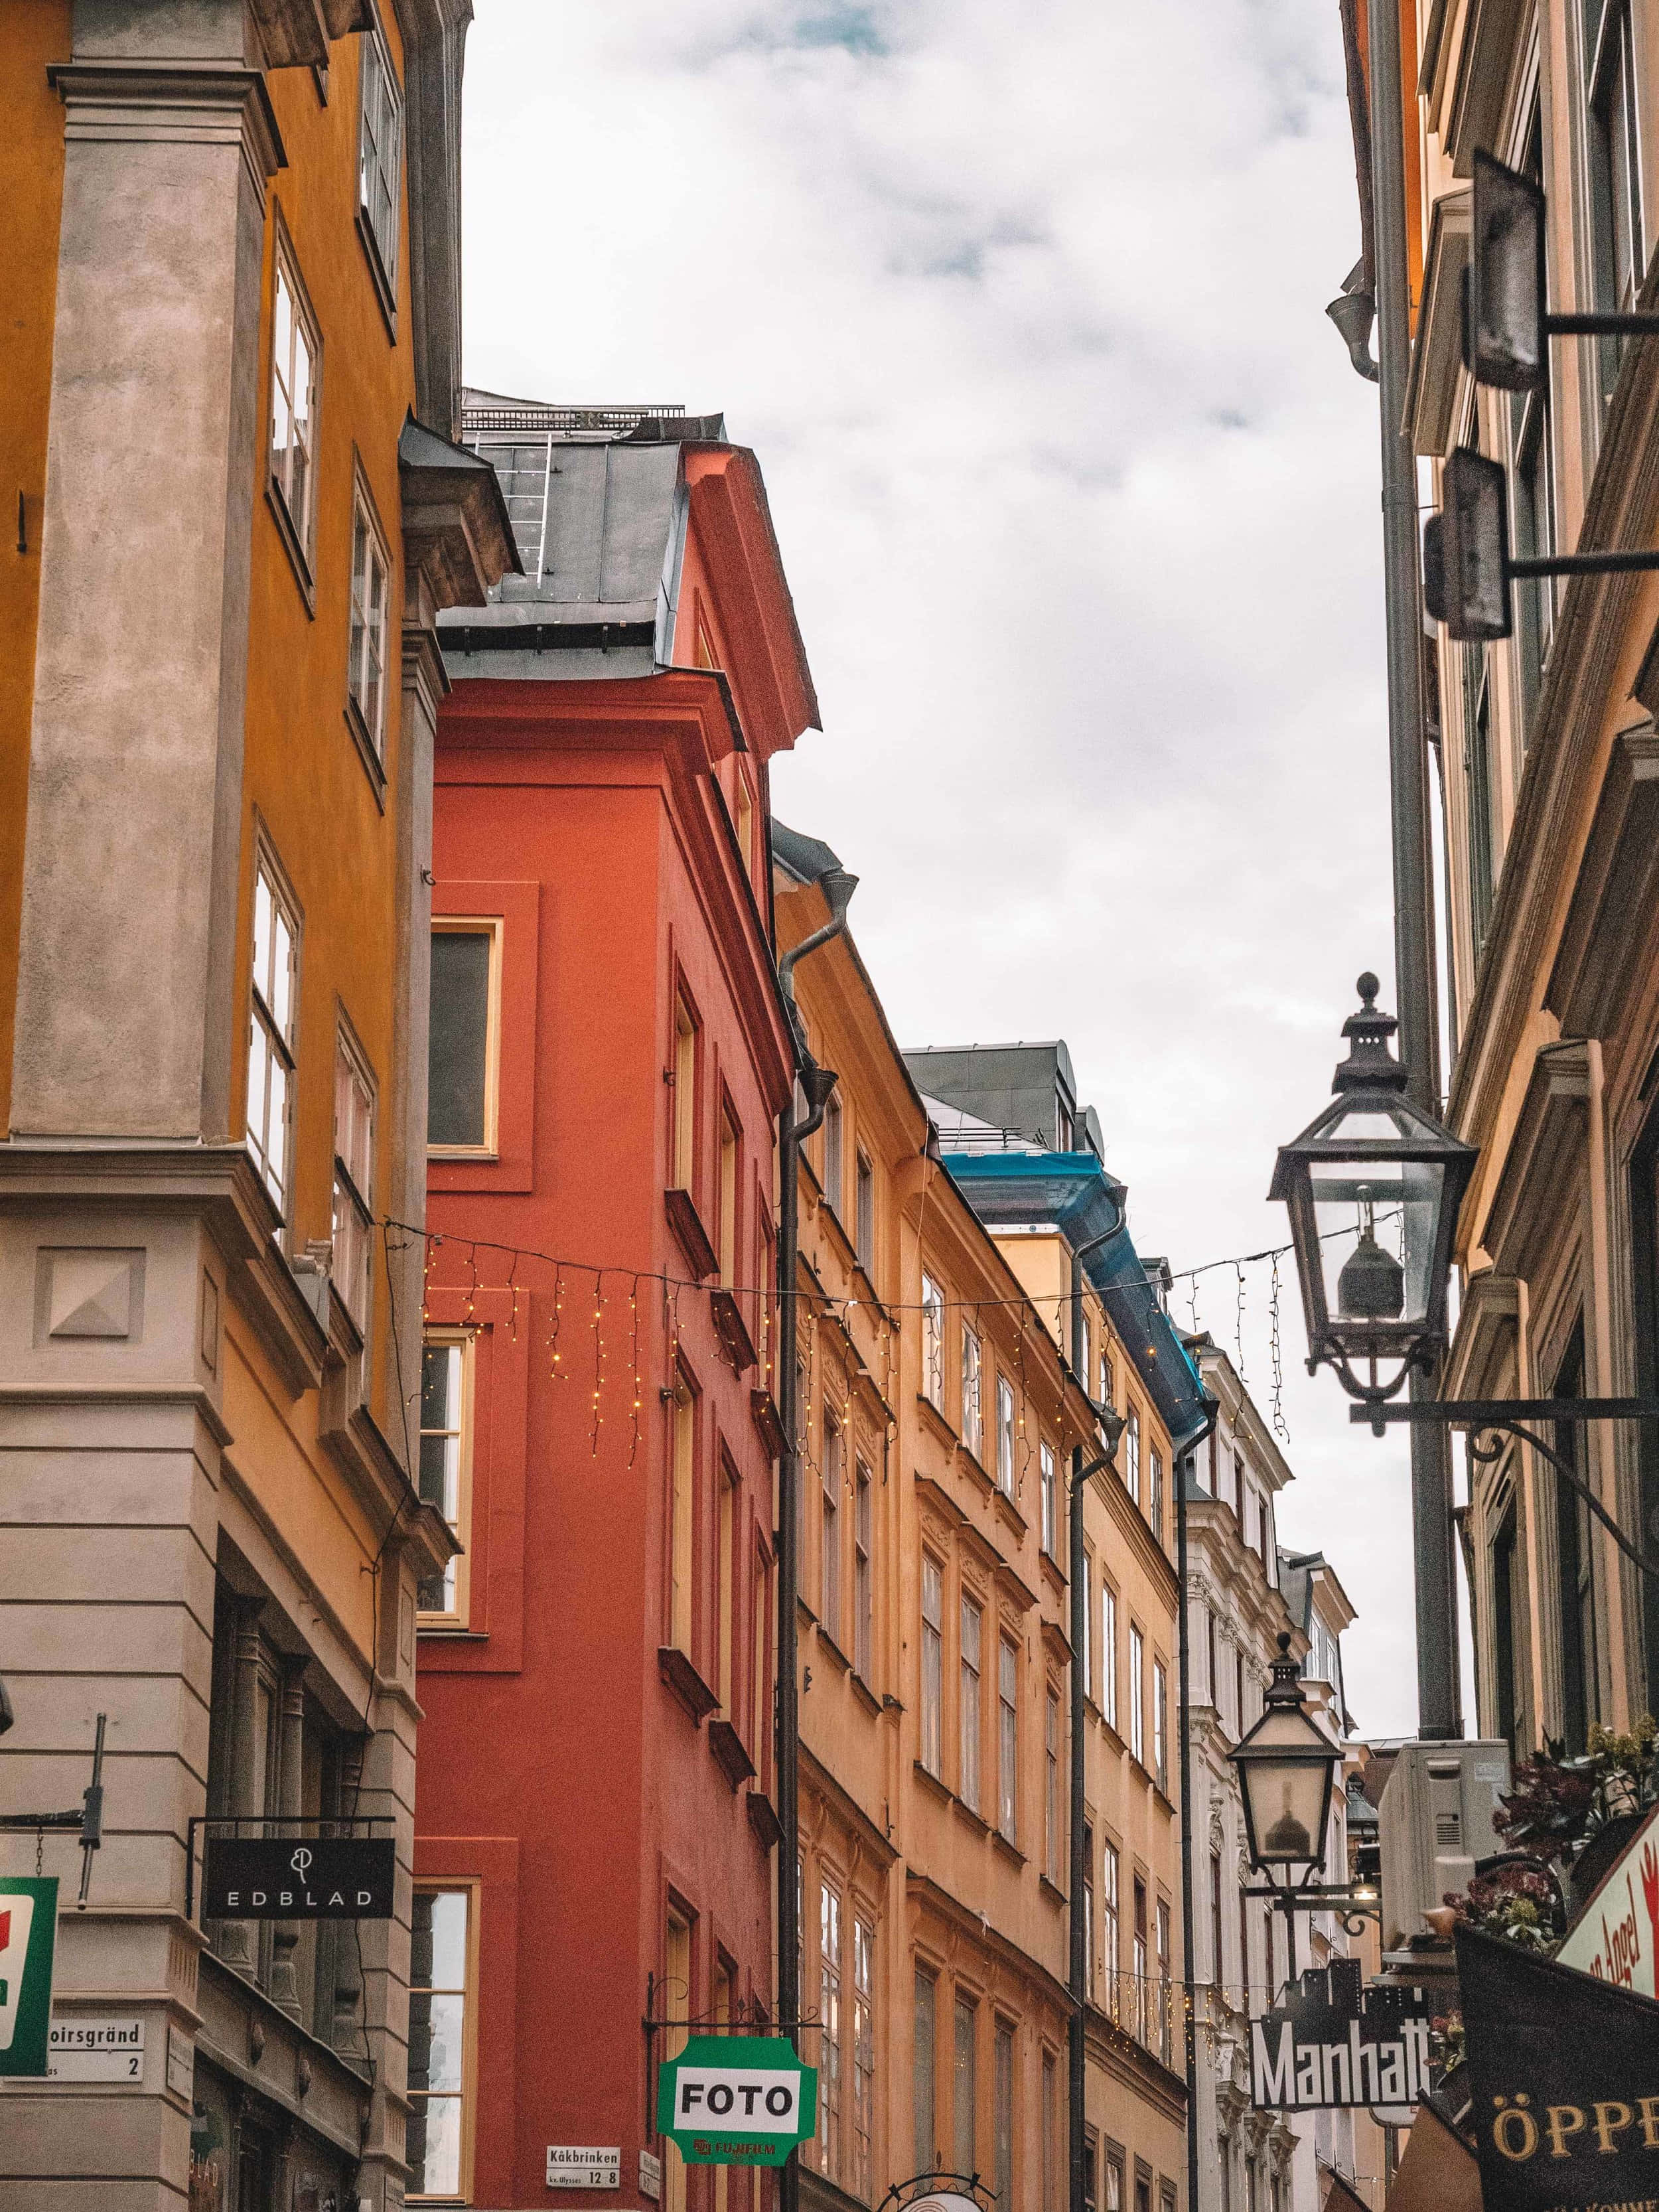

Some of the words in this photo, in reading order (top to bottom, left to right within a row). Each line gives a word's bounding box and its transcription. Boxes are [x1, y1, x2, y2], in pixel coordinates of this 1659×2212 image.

[228, 1891, 372, 1906] EDBLAD
[129, 2058, 139, 2075] 2
[1252, 2017, 1431, 2105] Manhatt
[682, 2083, 793, 2116] FOTO
[715, 2142, 775, 2155] FUJIFILM
[550, 2150, 618, 2164] Kåkbrinken
[559, 2176, 581, 2185] Ulysses
[589, 2172, 601, 2184] 12
[609, 2172, 616, 2184] 8
